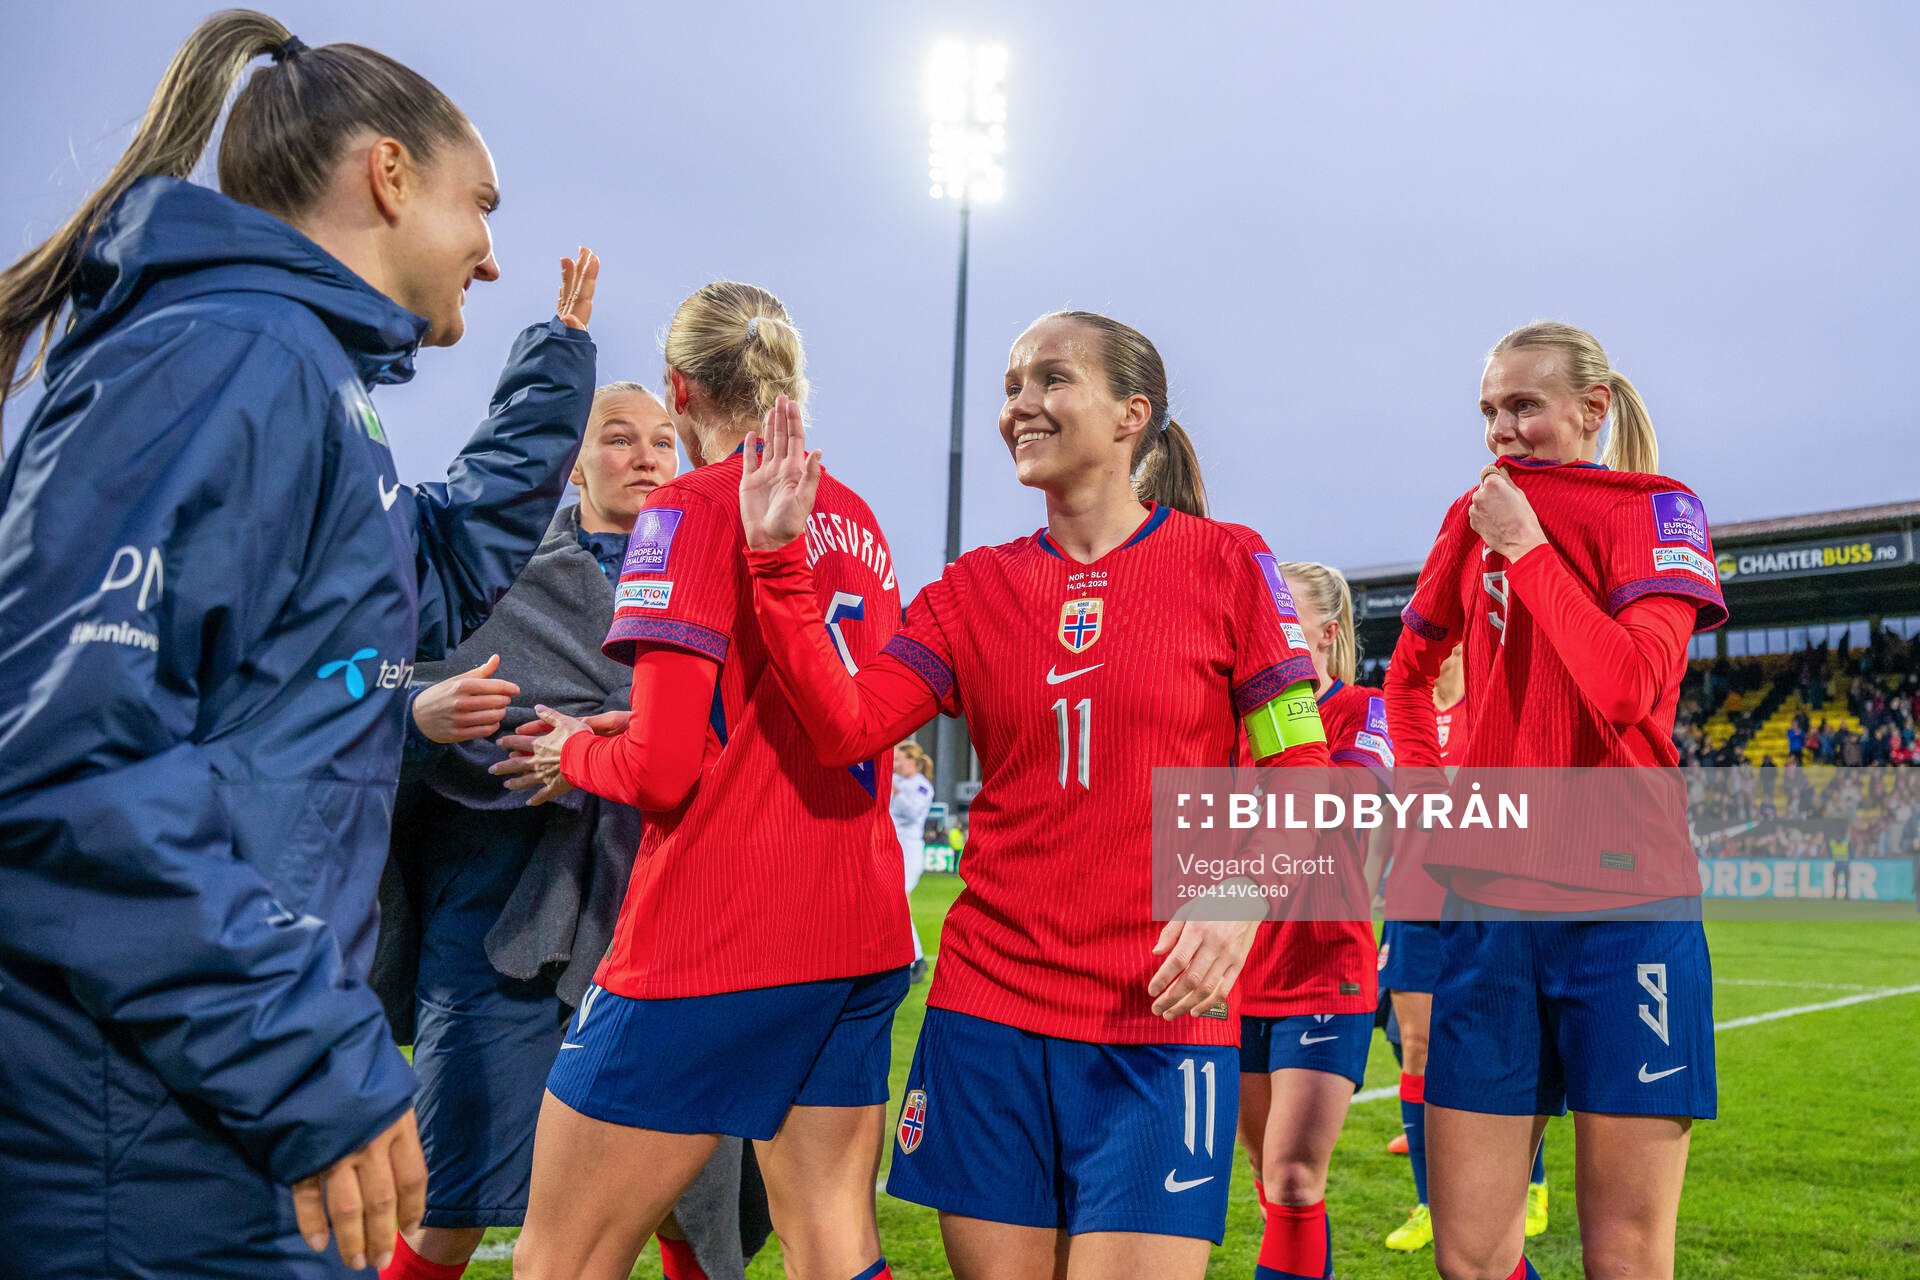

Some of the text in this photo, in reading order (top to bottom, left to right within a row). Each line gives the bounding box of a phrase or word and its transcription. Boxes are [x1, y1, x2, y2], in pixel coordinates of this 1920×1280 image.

[627, 547, 664, 559] EUROPEAN
[625, 555, 663, 567] QUALIFIERS
[1068, 572, 1085, 582] NOR
[1091, 571, 1108, 579] SLO
[1066, 580, 1108, 591] 14.04.2026
[1050, 698, 1092, 791] 11
[1637, 963, 1669, 1047] 9
[1178, 1058, 1216, 1159] 11
